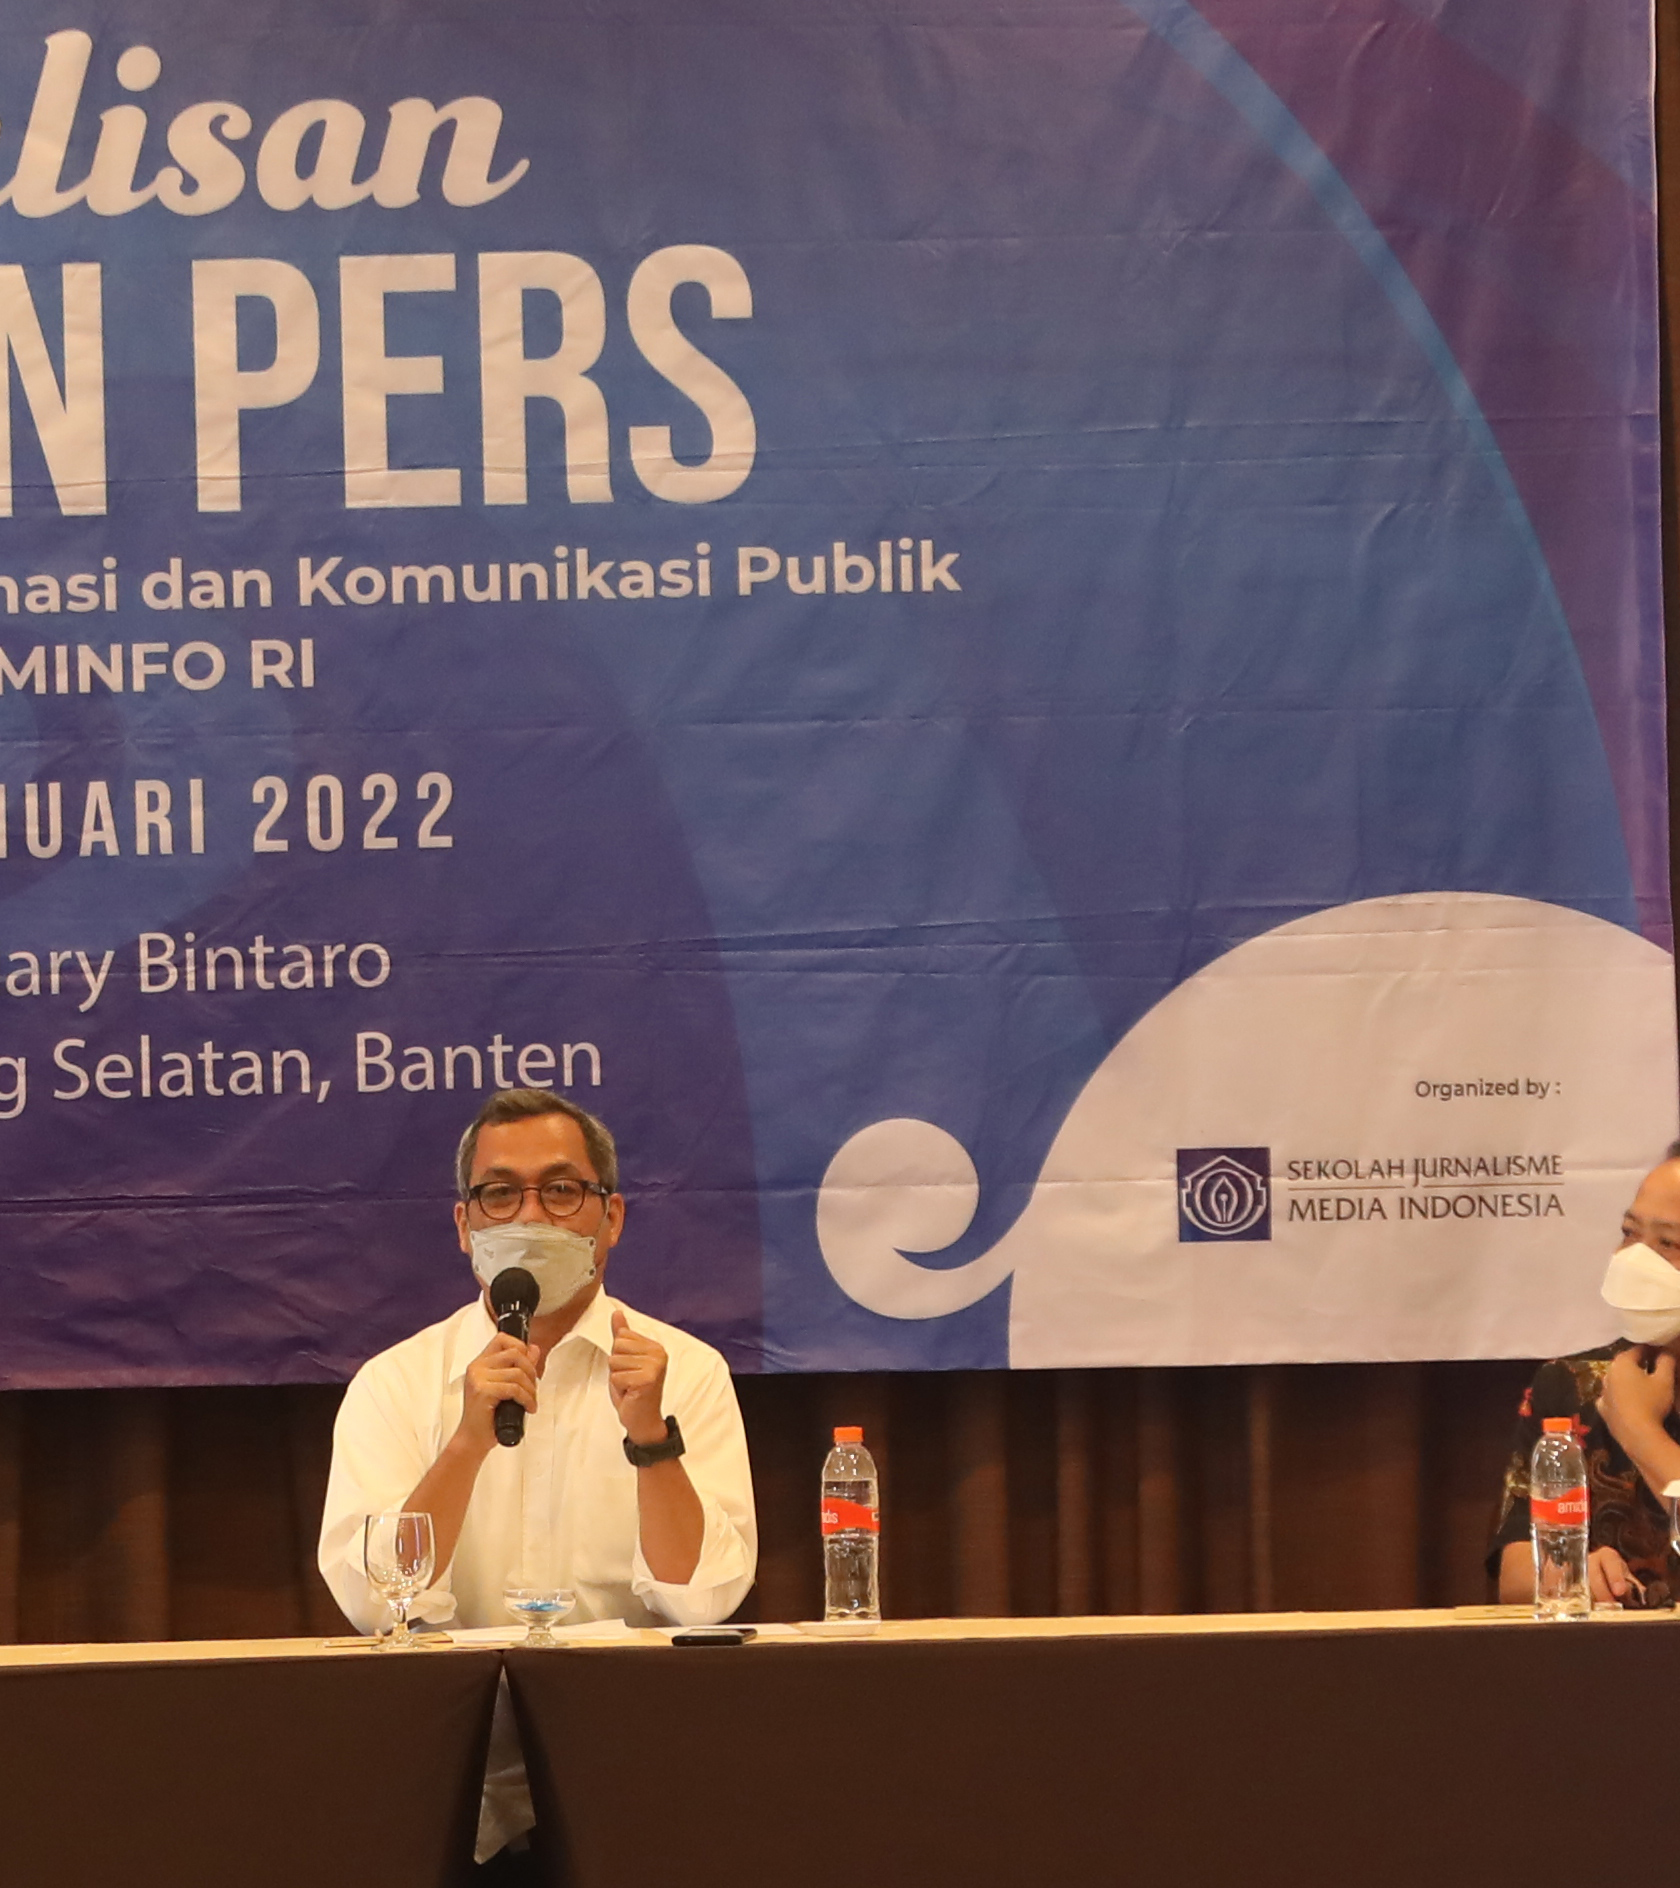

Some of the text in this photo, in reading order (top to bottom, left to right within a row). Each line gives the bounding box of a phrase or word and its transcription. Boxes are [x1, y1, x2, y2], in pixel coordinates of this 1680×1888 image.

[192, 245, 756, 511] PERS
[142, 558, 271, 609] dan
[299, 543, 710, 606] Komunikasi
[739, 539, 961, 595] Publik
[252, 639, 315, 688] RI
[253, 772, 452, 852] 2022
[140, 932, 390, 992] Bintaro
[54, 1035, 330, 1105] Selatan,
[357, 1032, 600, 1095] Banten
[1415, 1079, 1520, 1100] Organized
[1526, 1078, 1550, 1098] by
[1287, 1154, 1562, 1187] SEKOLAH JURNALISME
[1287, 1194, 1566, 1221] MEDIA INDONESIA
